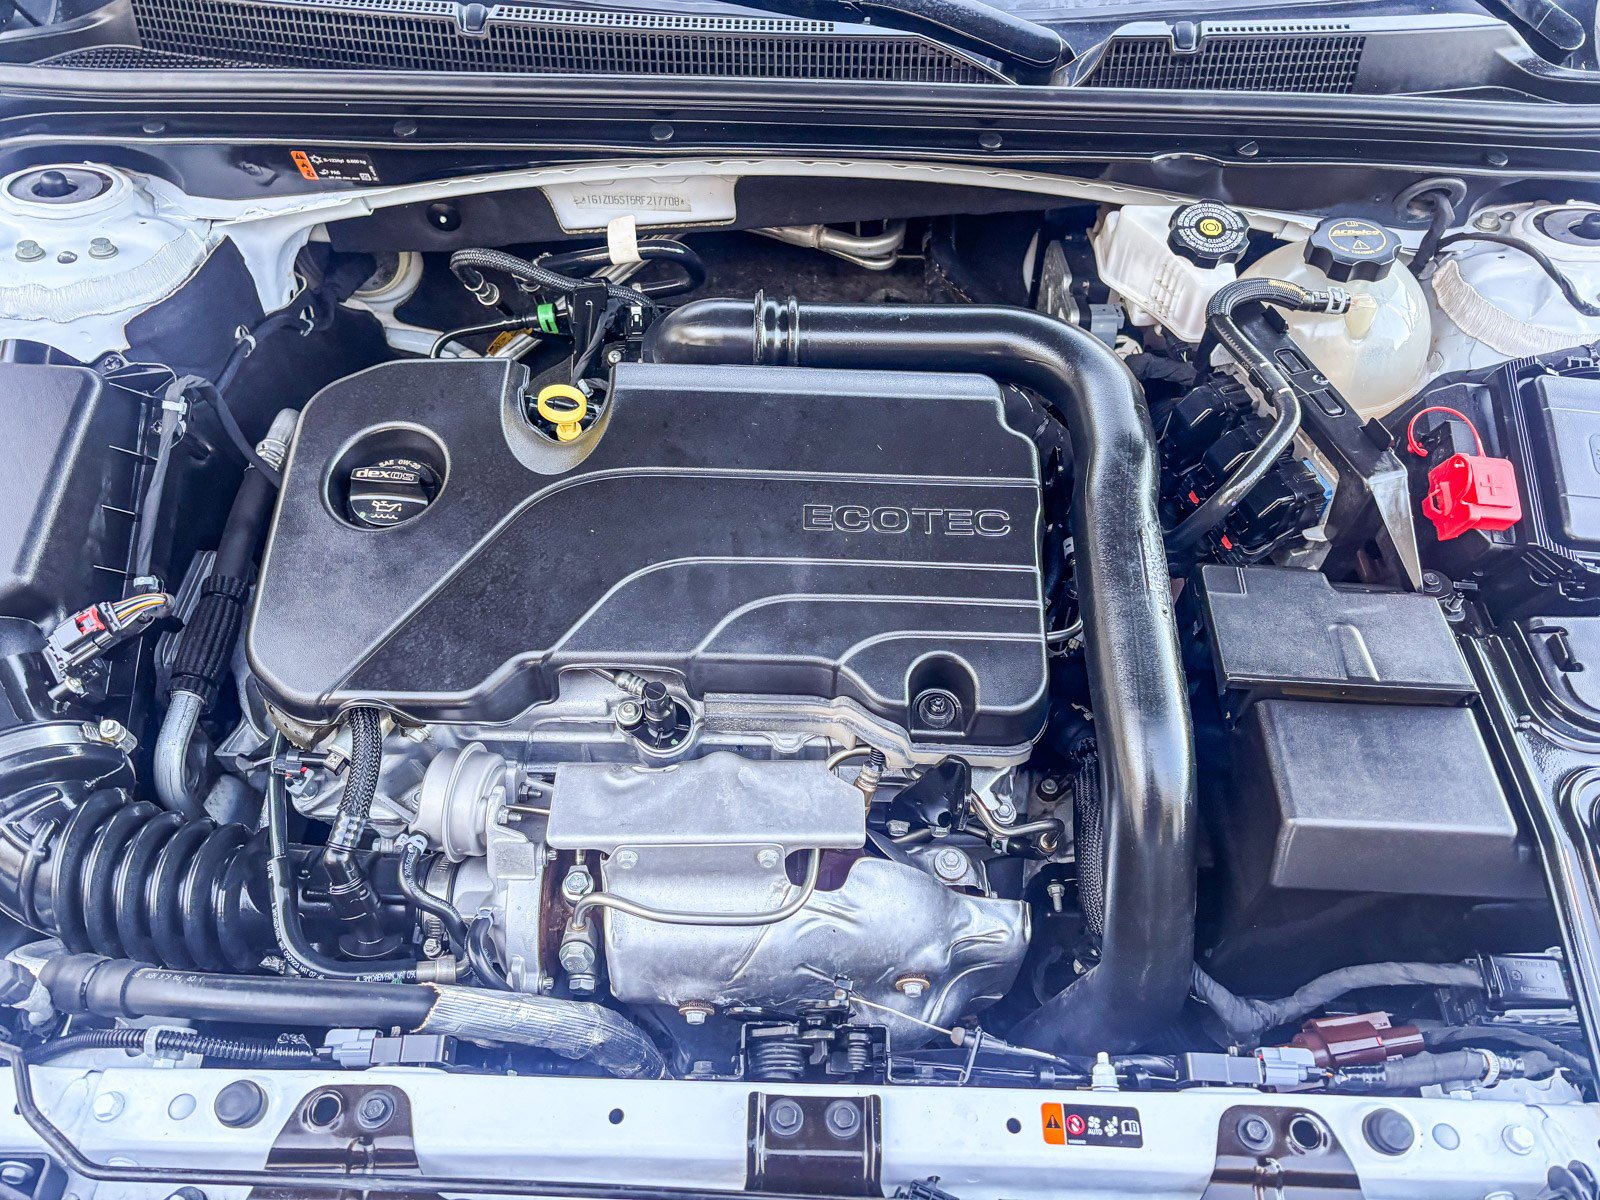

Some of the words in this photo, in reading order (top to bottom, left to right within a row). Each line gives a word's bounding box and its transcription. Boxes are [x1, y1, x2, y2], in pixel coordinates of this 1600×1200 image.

[398, 460, 421, 469] 0W-20
[356, 468, 415, 481] dexos
[802, 504, 1011, 537] ECOTEC
[1087, 1128, 1103, 1136] AUTO
